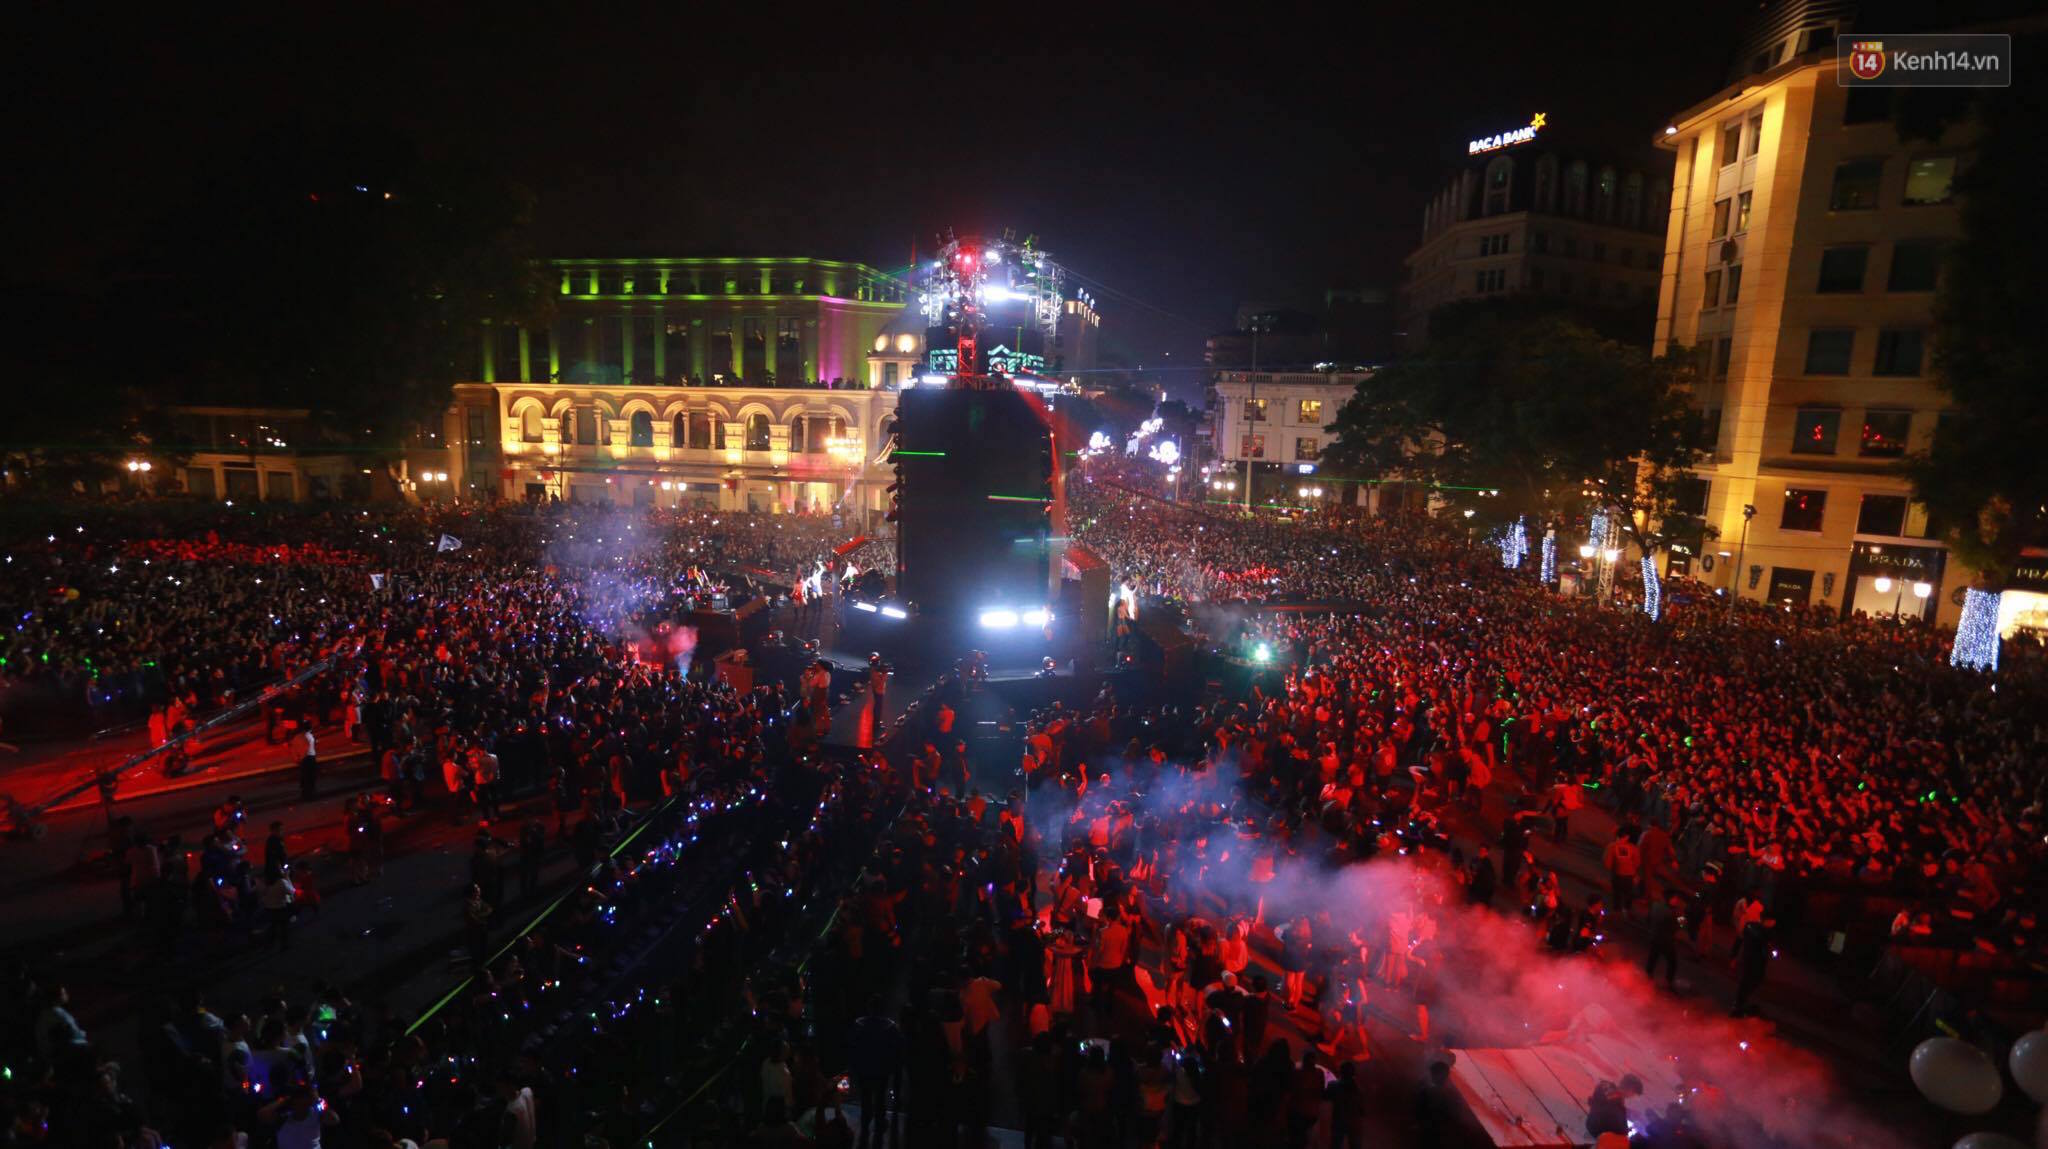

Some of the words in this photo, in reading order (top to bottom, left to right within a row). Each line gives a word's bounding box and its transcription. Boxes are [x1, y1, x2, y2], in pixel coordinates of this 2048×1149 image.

[1469, 137, 1493, 153] BAC
[1492, 134, 1502, 147] A
[1503, 126, 1537, 145] BANK
[1869, 554, 1923, 568] PRADA
